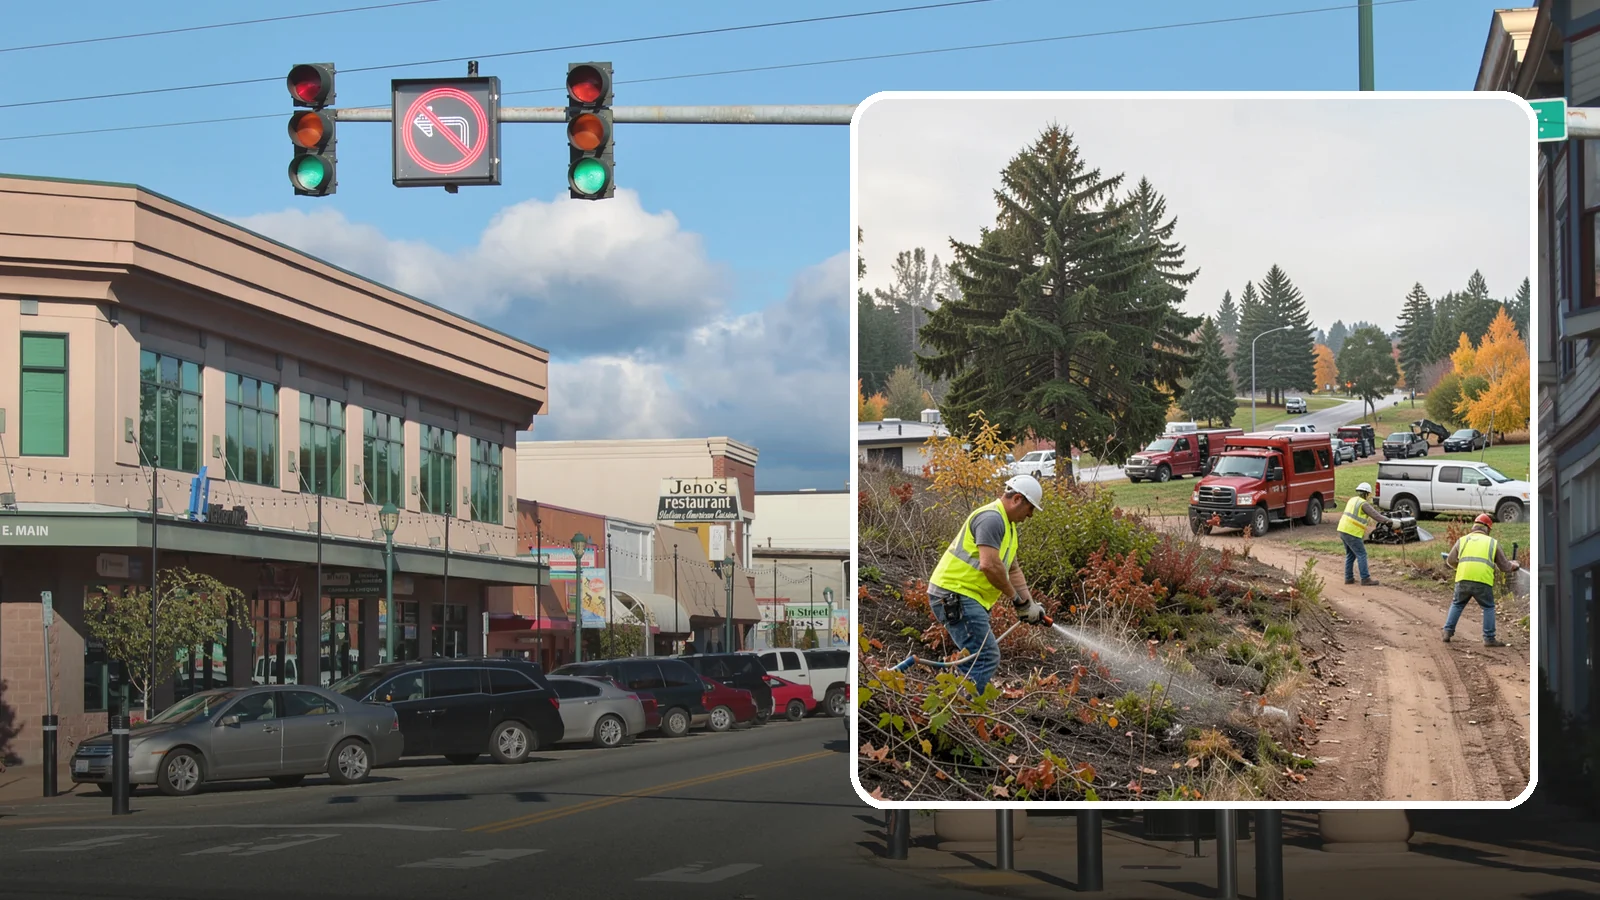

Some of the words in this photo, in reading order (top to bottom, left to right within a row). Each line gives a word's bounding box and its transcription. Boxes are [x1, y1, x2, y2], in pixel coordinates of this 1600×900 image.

[670, 480, 727, 494] Jeno's
[665, 496, 731, 509] restaurant
[686, 509, 715, 519] American
[715, 509, 737, 519] Cuisine
[2, 525, 13, 536] E.
[15, 525, 49, 536] MAIN
[797, 607, 828, 616] Street
[791, 619, 823, 627] lass
